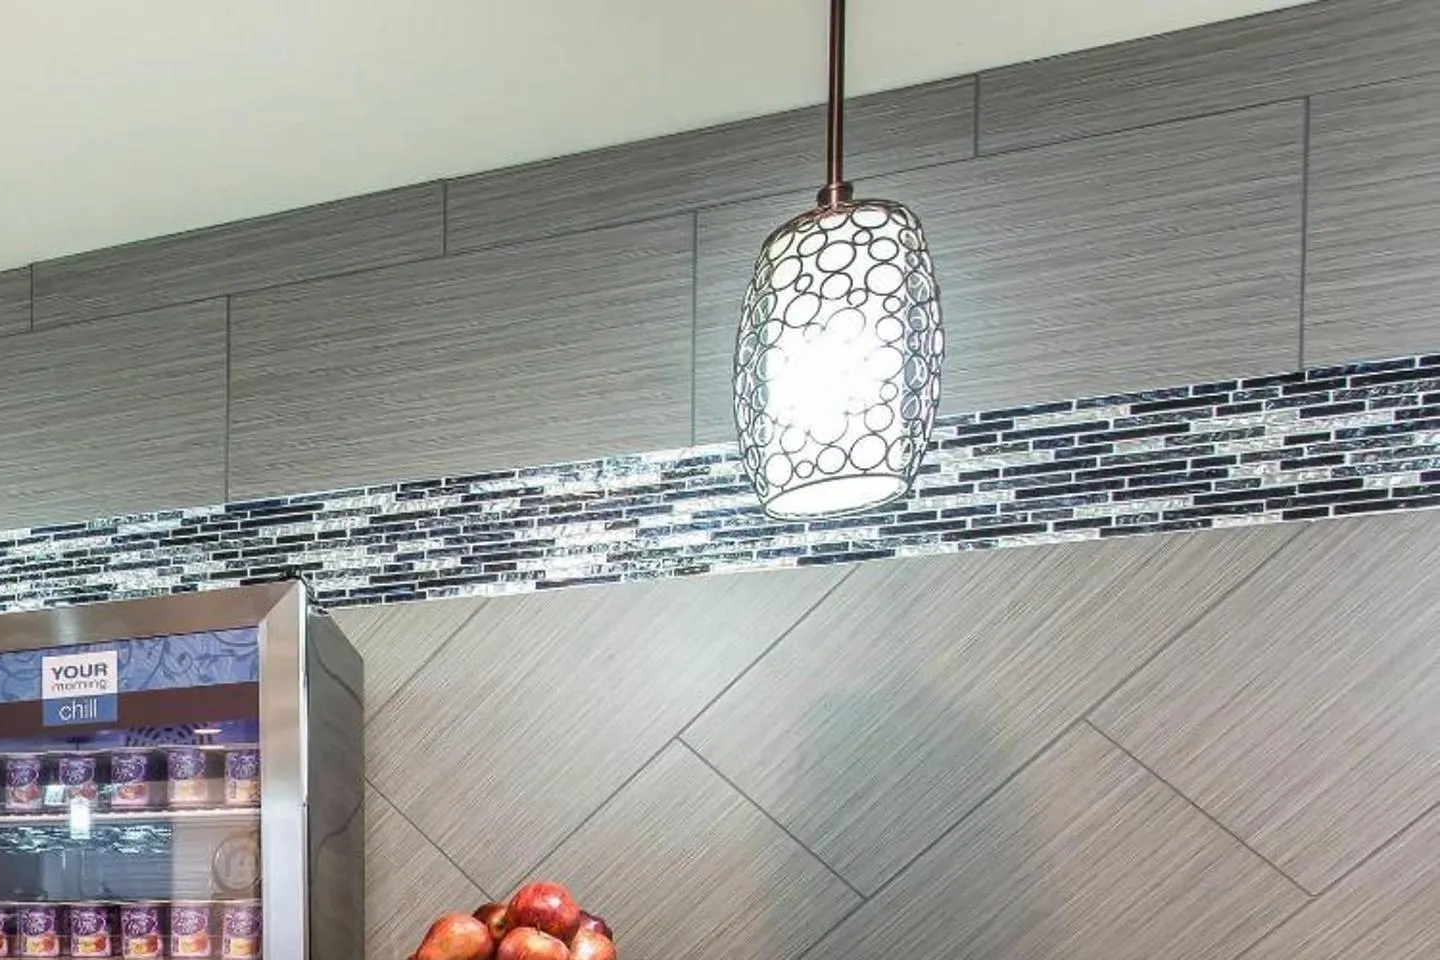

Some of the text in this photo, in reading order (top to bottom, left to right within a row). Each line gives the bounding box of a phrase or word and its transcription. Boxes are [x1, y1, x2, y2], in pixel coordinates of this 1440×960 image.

[51, 662, 108, 680] YOUR
[51, 679, 106, 691] morning
[59, 697, 97, 720] chill
